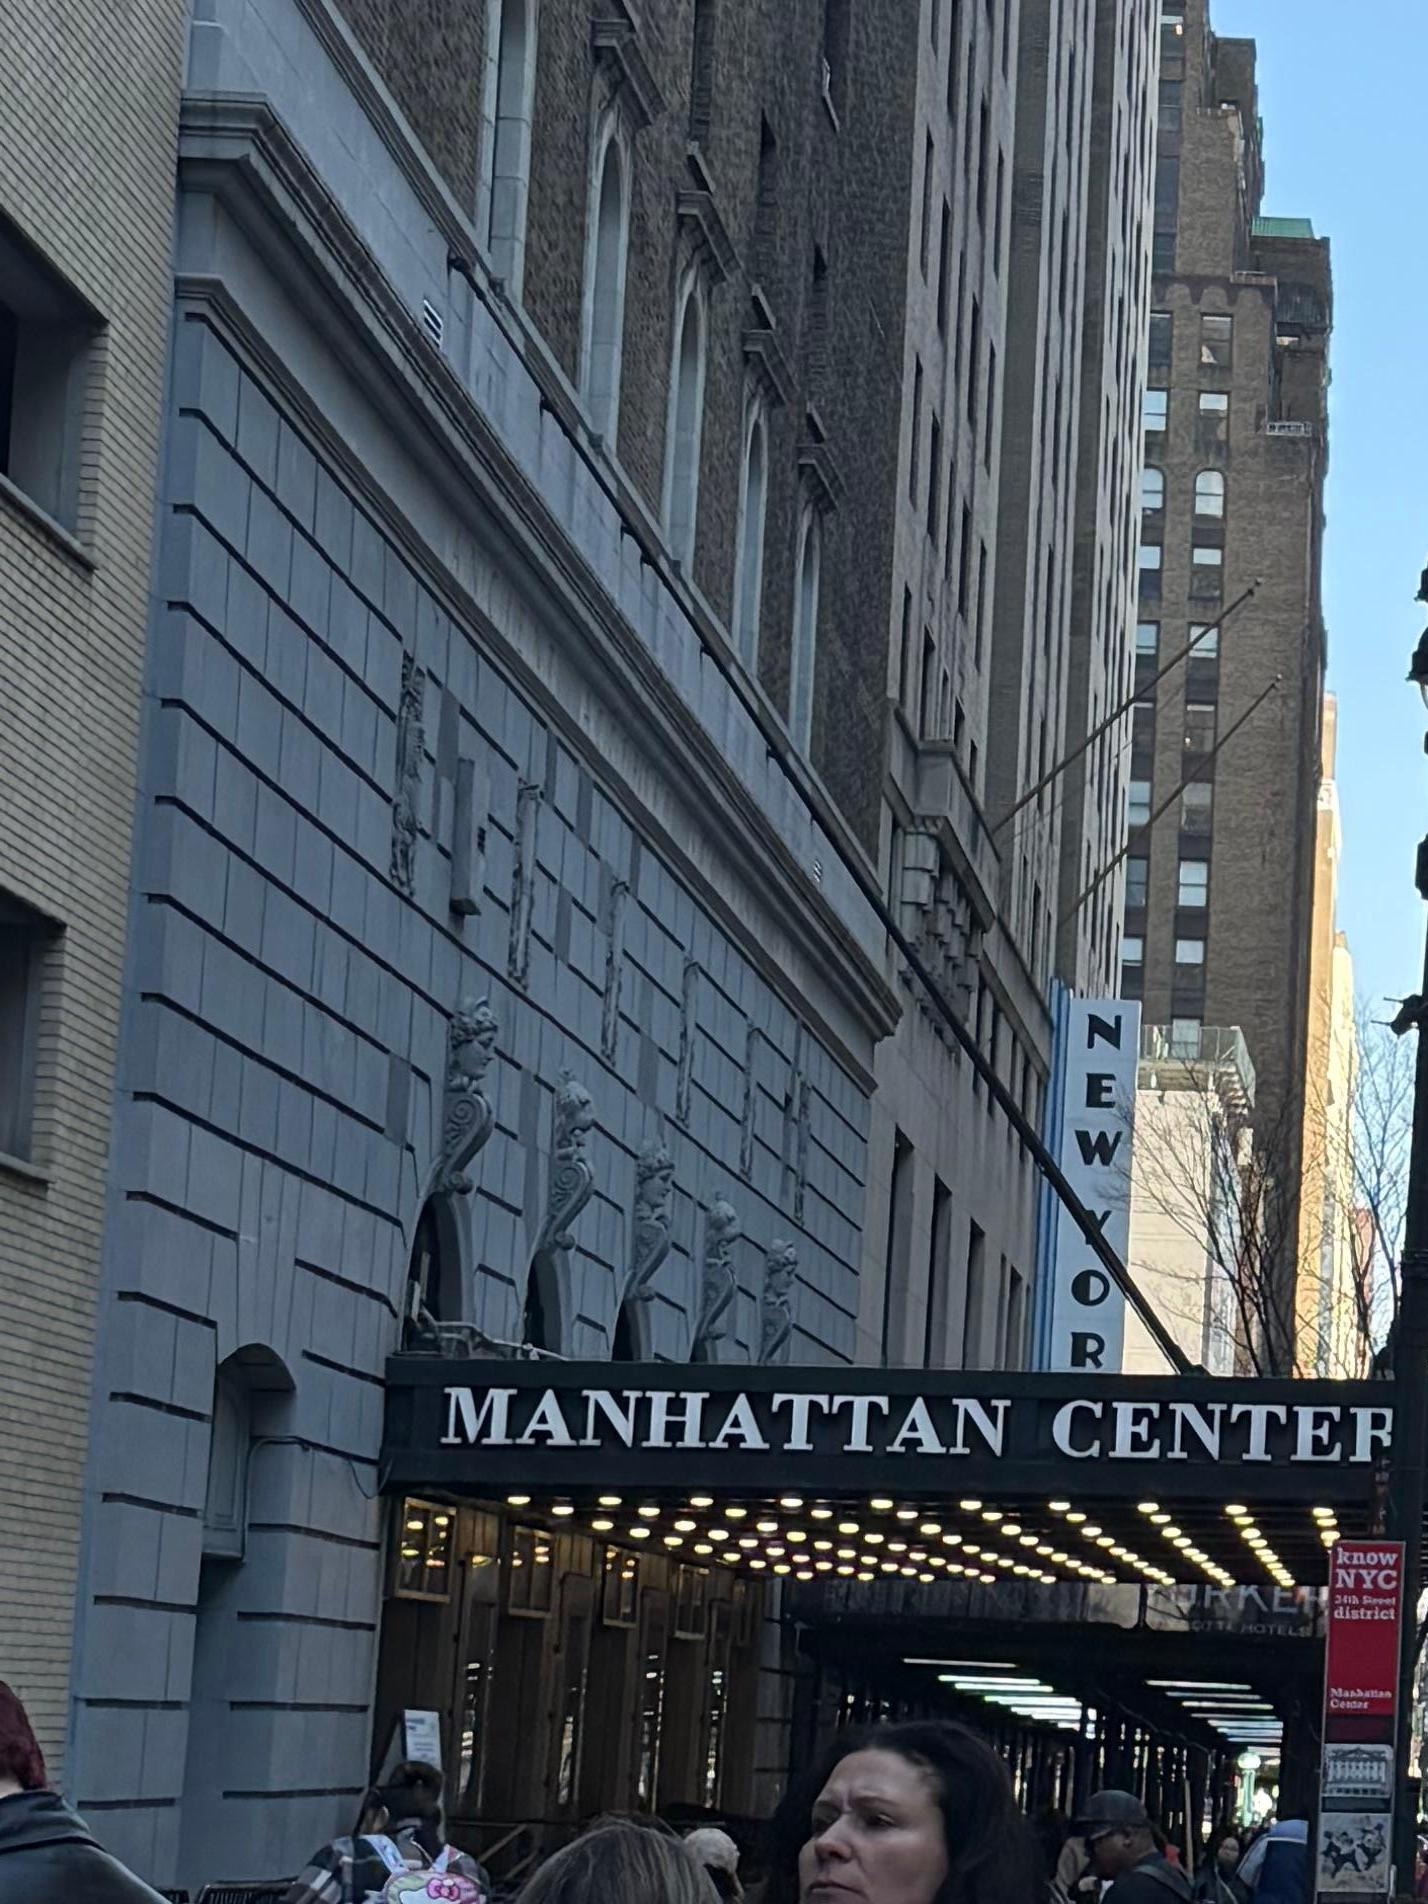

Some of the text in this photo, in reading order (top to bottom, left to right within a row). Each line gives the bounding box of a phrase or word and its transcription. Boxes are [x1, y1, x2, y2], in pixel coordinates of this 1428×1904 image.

[1075, 1013, 1122, 1167] NEW
[441, 1386, 1393, 1463] MANHATTAN CENTER
[1336, 1546, 1399, 1566] know
[1335, 1568, 1398, 1590] NYC
[1362, 1595, 1396, 1605] Street
[1333, 1606, 1396, 1620] district
[1329, 1687, 1393, 1698] Manhattan
[1329, 1698, 1370, 1710] Center
